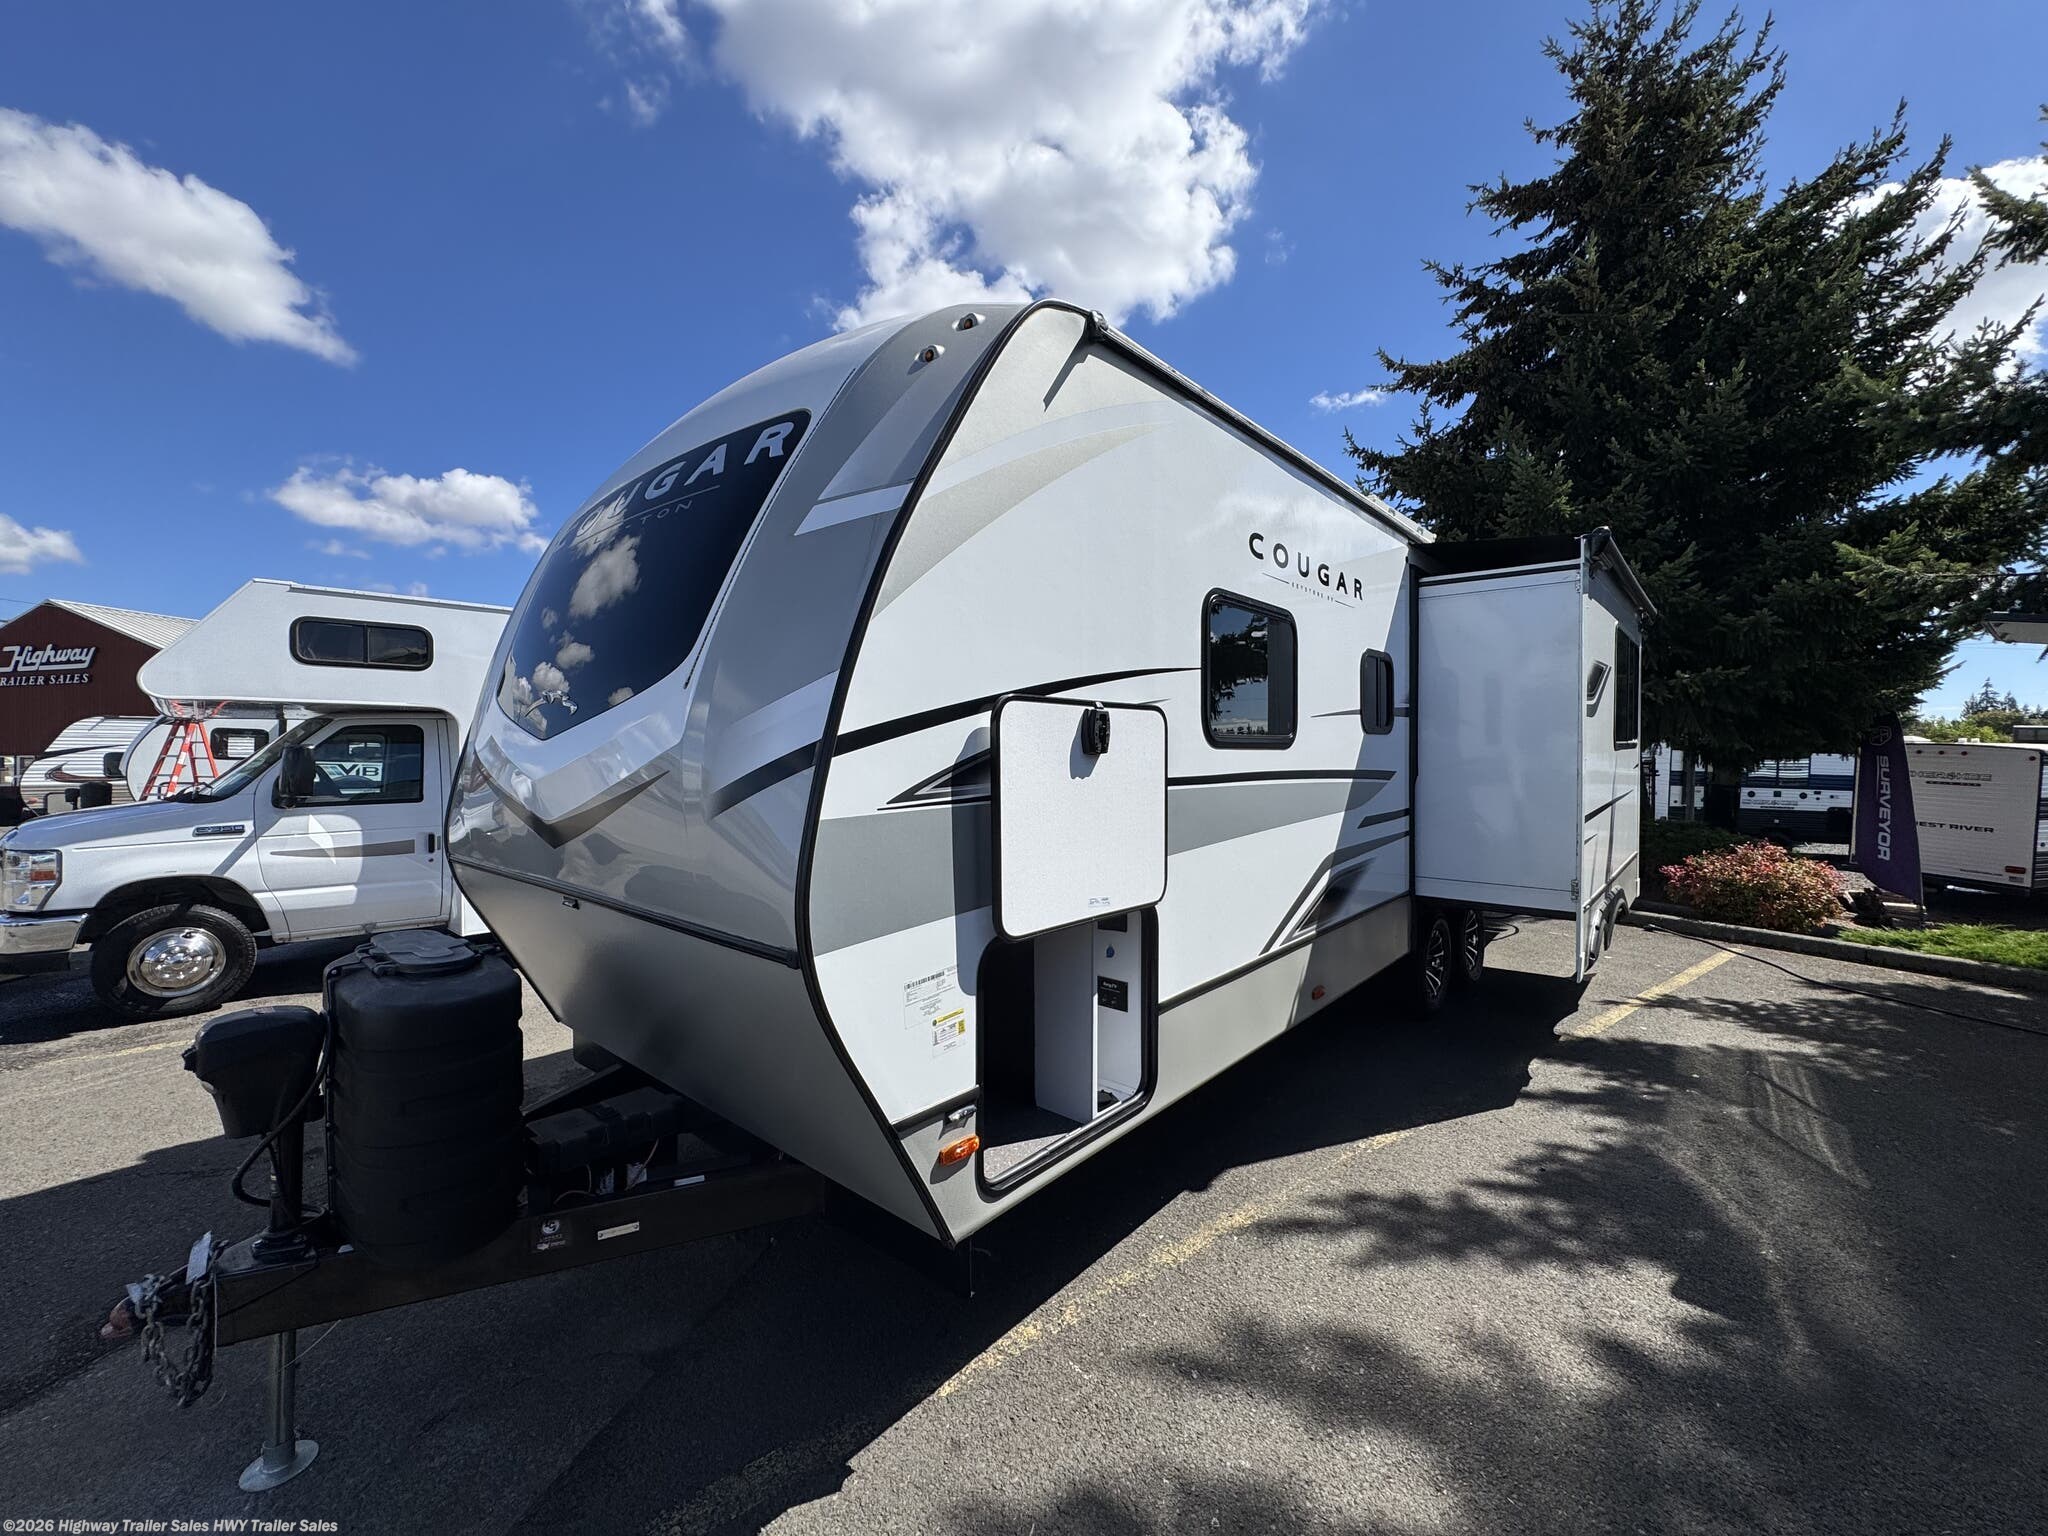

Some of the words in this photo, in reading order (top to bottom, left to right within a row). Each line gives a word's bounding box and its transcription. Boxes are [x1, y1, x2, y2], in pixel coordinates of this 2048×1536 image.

[562, 421, 795, 547] OUGAR
[1249, 532, 1363, 601] COUGAR
[0, 643, 97, 673] Highway
[0, 675, 45, 687] RAILER
[49, 672, 90, 685] SALES
[1877, 755, 1892, 861] SURVEYOR
[1916, 821, 1947, 829] EST
[1949, 823, 1995, 833] RIVER
